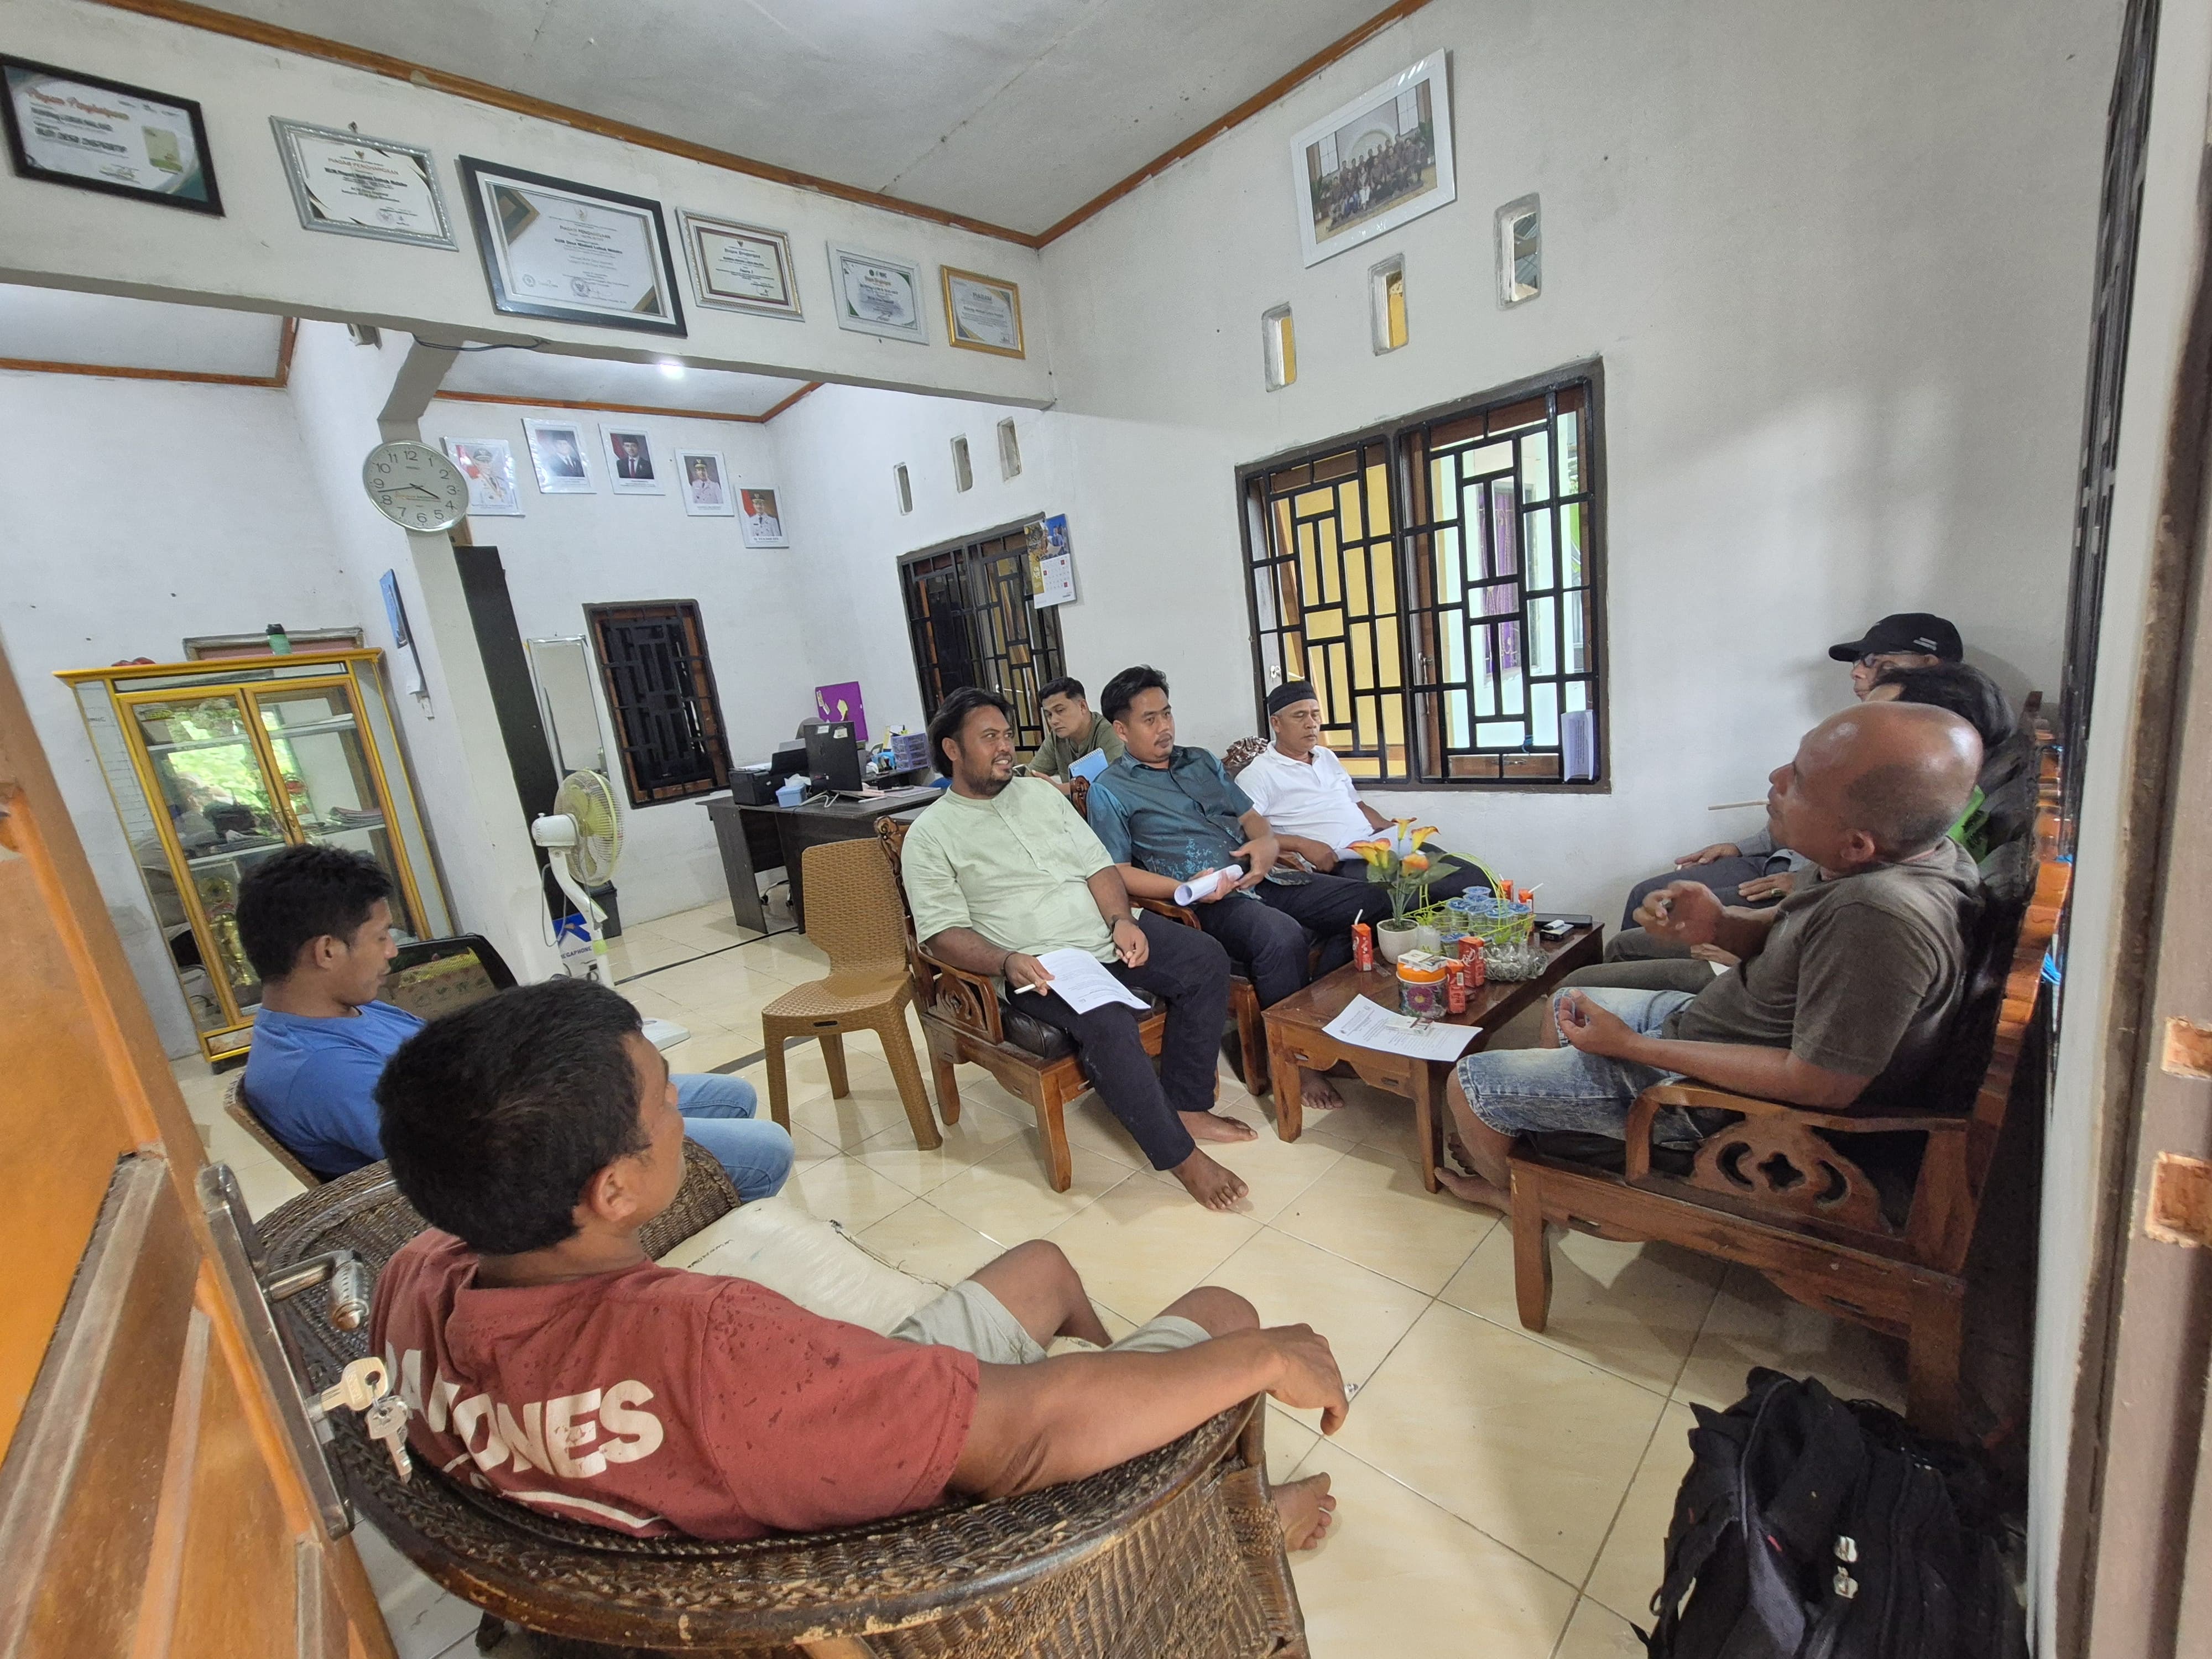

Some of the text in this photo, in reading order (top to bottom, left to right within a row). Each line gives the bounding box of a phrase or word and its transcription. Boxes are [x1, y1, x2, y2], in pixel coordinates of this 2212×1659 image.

[388, 453, 398, 463] 11
[404, 451, 418, 461] 12
[377, 463, 391, 473] 10
[439, 470, 450, 479] 2
[373, 478, 384, 489] 9
[446, 485, 457, 495] 3
[382, 495, 392, 505] 8
[445, 500, 457, 510] 4
[397, 507, 406, 517] 7
[434, 510, 444, 520] 5
[417, 513, 427, 523] 6
